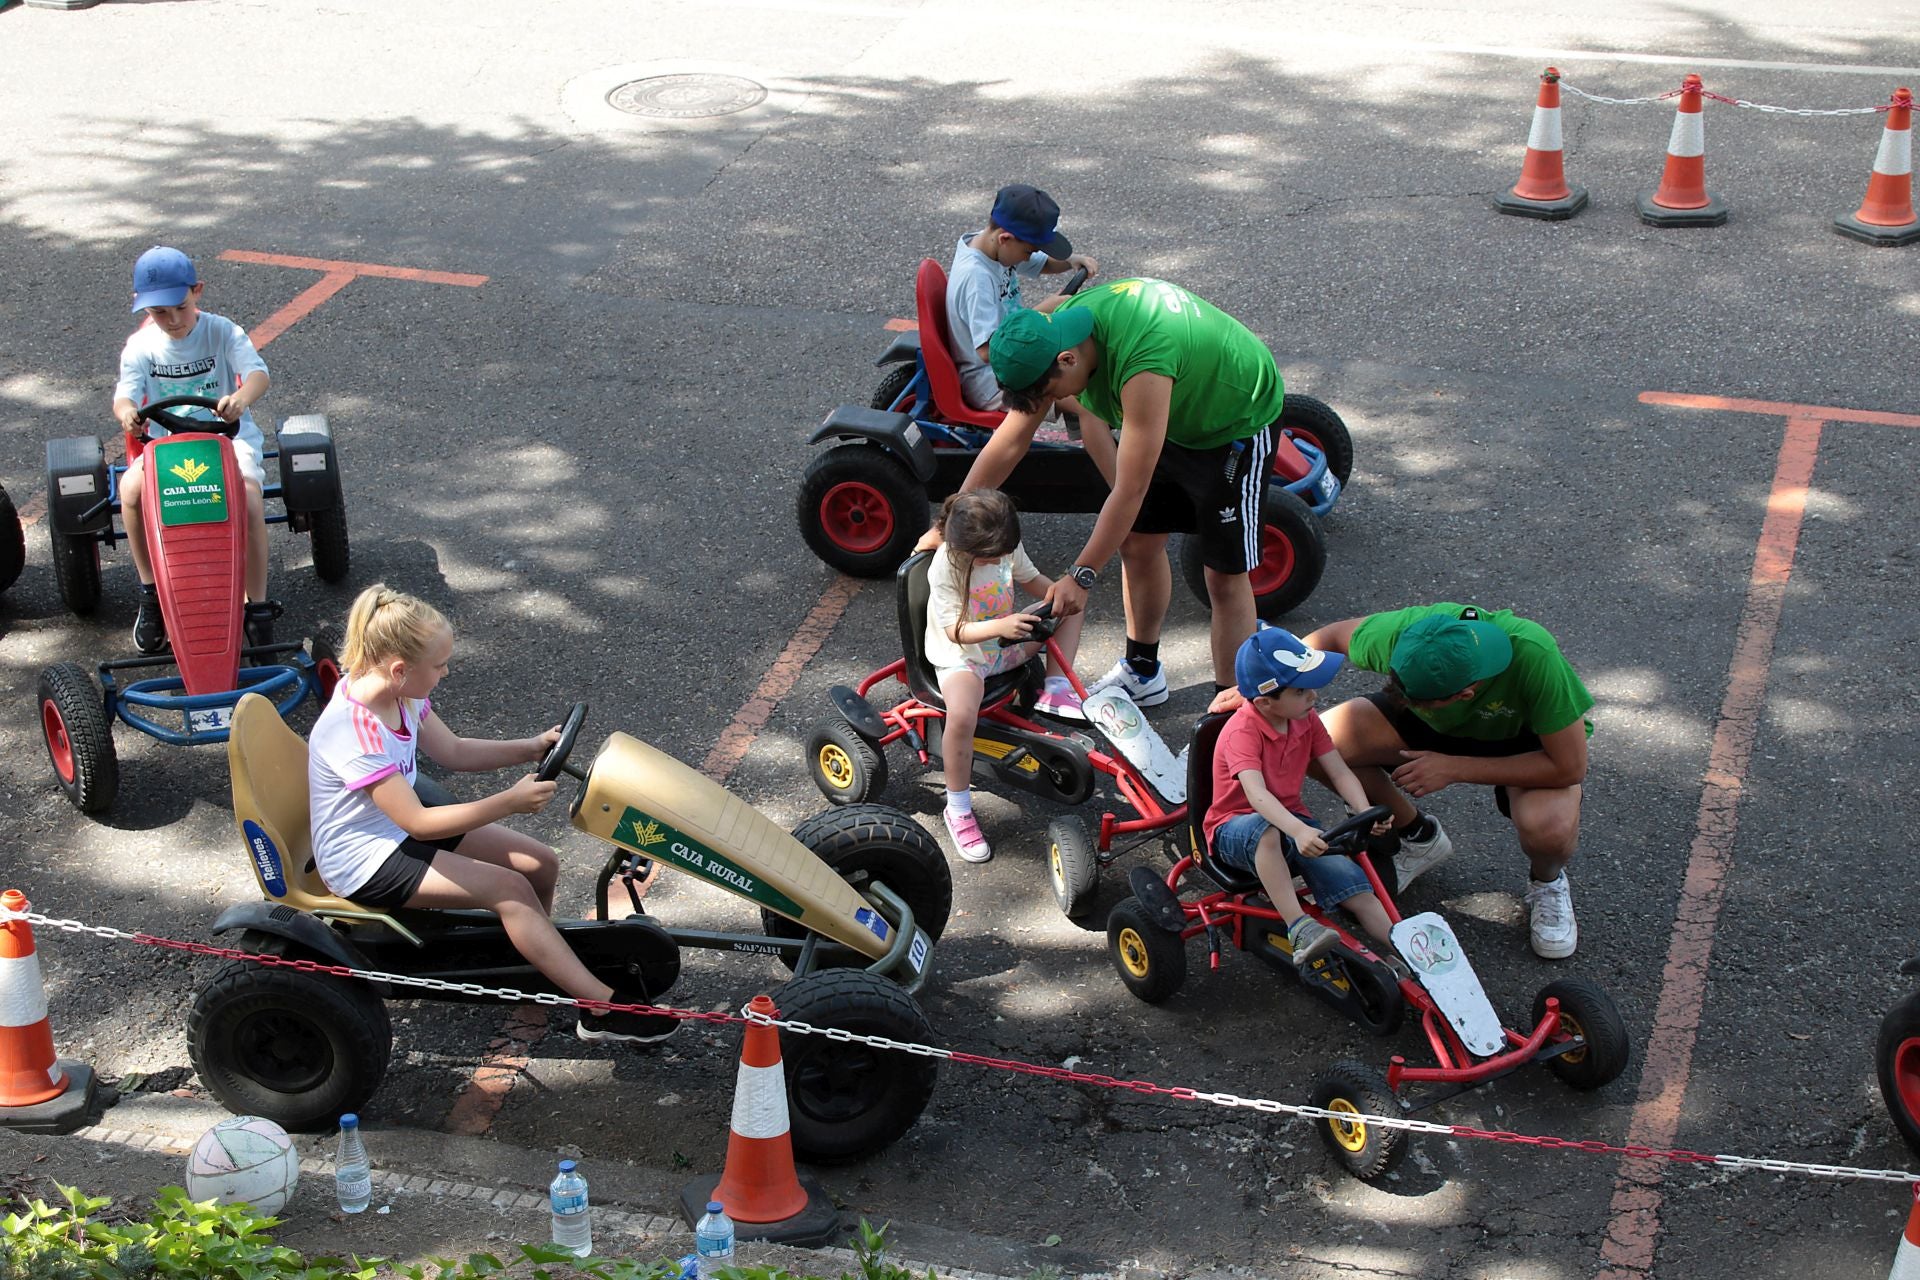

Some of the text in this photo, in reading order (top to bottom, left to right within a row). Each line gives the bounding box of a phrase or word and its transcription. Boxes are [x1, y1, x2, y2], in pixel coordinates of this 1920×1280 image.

[150, 356, 216, 378] MINECRAF
[163, 484, 221, 495] CAJA RURAL
[254, 838, 276, 881] Relieves
[670, 842, 754, 892] CAJA RURAL
[733, 943, 782, 955] SAFARI
[911, 939, 924, 967] 10
